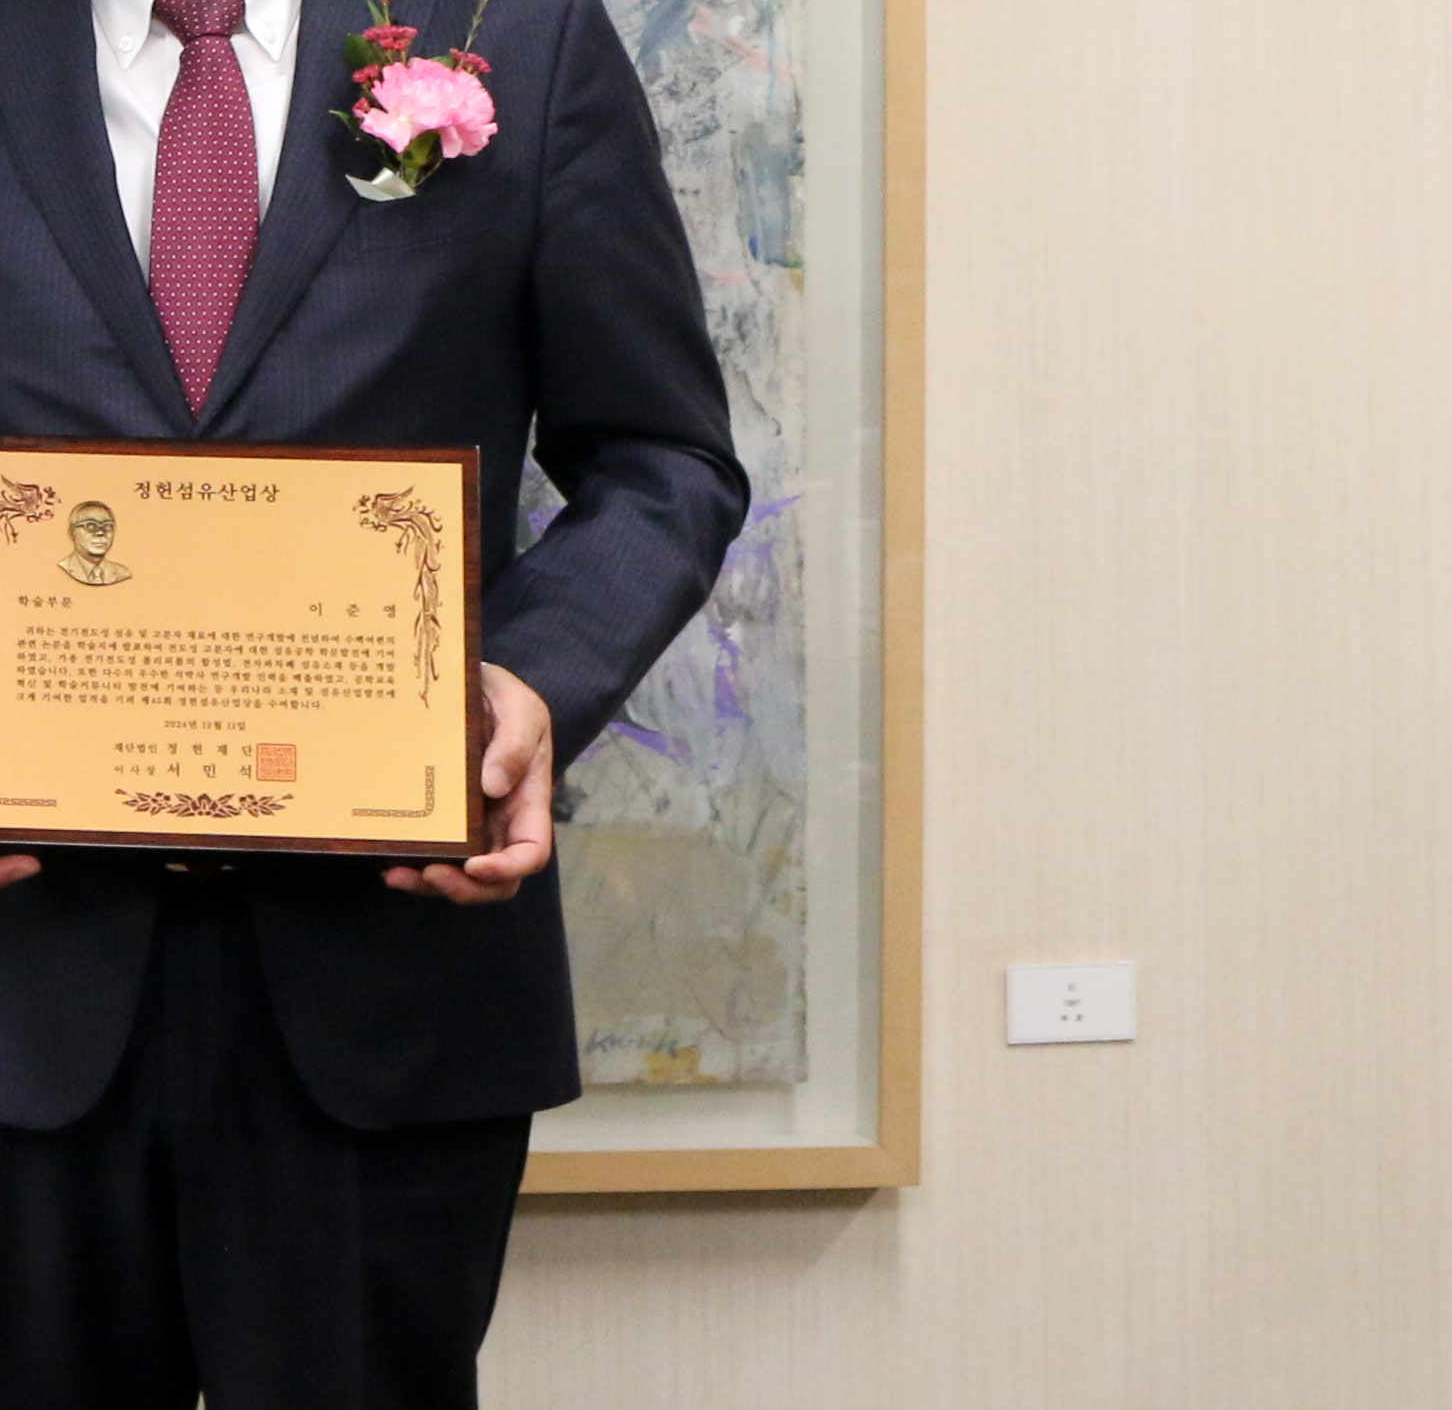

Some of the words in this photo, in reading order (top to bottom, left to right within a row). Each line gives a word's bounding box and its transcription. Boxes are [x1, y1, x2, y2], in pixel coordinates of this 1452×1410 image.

[133, 480, 280, 503] 정헌섬유산업상
[17, 595, 72, 608] 학술부문
[25, 625, 55, 636] 귀하는
[60, 627, 109, 638] 전기전도성
[114, 628, 133, 638] 섬유
[138, 628, 147, 638] 및
[152, 630, 181, 639] 고분자
[187, 630, 216, 640] 재료에
[220, 631, 240, 641] 대한
[245, 632, 295, 642] 연구개발에
[345, 634, 395, 645] 수백여편의
[16, 638, 36, 649] 관련
[41, 639, 71, 649] 논문을
[76, 640, 117, 651] 학술지에
[121, 641, 162, 652] 발표하여
[168, 643, 197, 653] 전도성
[203, 644, 243, 655] 고분자에
[248, 645, 268, 655] 대한
[274, 645, 313, 656] 섬유공학
[319, 647, 370, 658] 학문발전에
[376, 648, 394, 658] 기여
[16, 651, 51, 662] 하였고,
[84, 653, 136, 665] 전기전도성
[200, 657, 235, 667] 합성법,
[242, 658, 294, 669] 전자파차폐
[300, 659, 343, 670] 섬유소재
[349, 661, 368, 671] 등을
[375, 661, 395, 672] 개발
[16, 665, 74, 676] 하였습니다.
[77, 667, 97, 677] 또한
[102, 667, 132, 677] 다수의
[138, 668, 168, 679] 우수한
[210, 670, 251, 681] 연구개발
[256, 671, 287, 682] 인력을
[292, 673, 348, 684] 배출하였고,
[354, 674, 394, 685] 공학교육
[16, 678, 36, 688] 혁신
[42, 679, 51, 689] 및
[57, 679, 121, 691] 학술커뮤니티
[127, 681, 159, 692] 발전에
[166, 682, 207, 693] 기여하는
[214, 684, 223, 694] 등
[229, 684, 271, 695] 우리나라
[277, 686, 298, 696] 소재
[304, 686, 313, 696] 및
[320, 687, 395, 698] 섬유산업발전에
[17, 691, 36, 701] 크게
[42, 692, 72, 703] 기여한
[78, 693, 108, 704] 업적을
[141, 695, 171, 705] 제45회
[178, 696, 261, 708] 정헌섬유산업상을
[267, 699, 323, 710] 수여합니다.
[164, 719, 196, 729] 2024년
[202, 720, 222, 730] 12월
[227, 721, 245, 731] 11일
[114, 742, 157, 753] 재단법인
